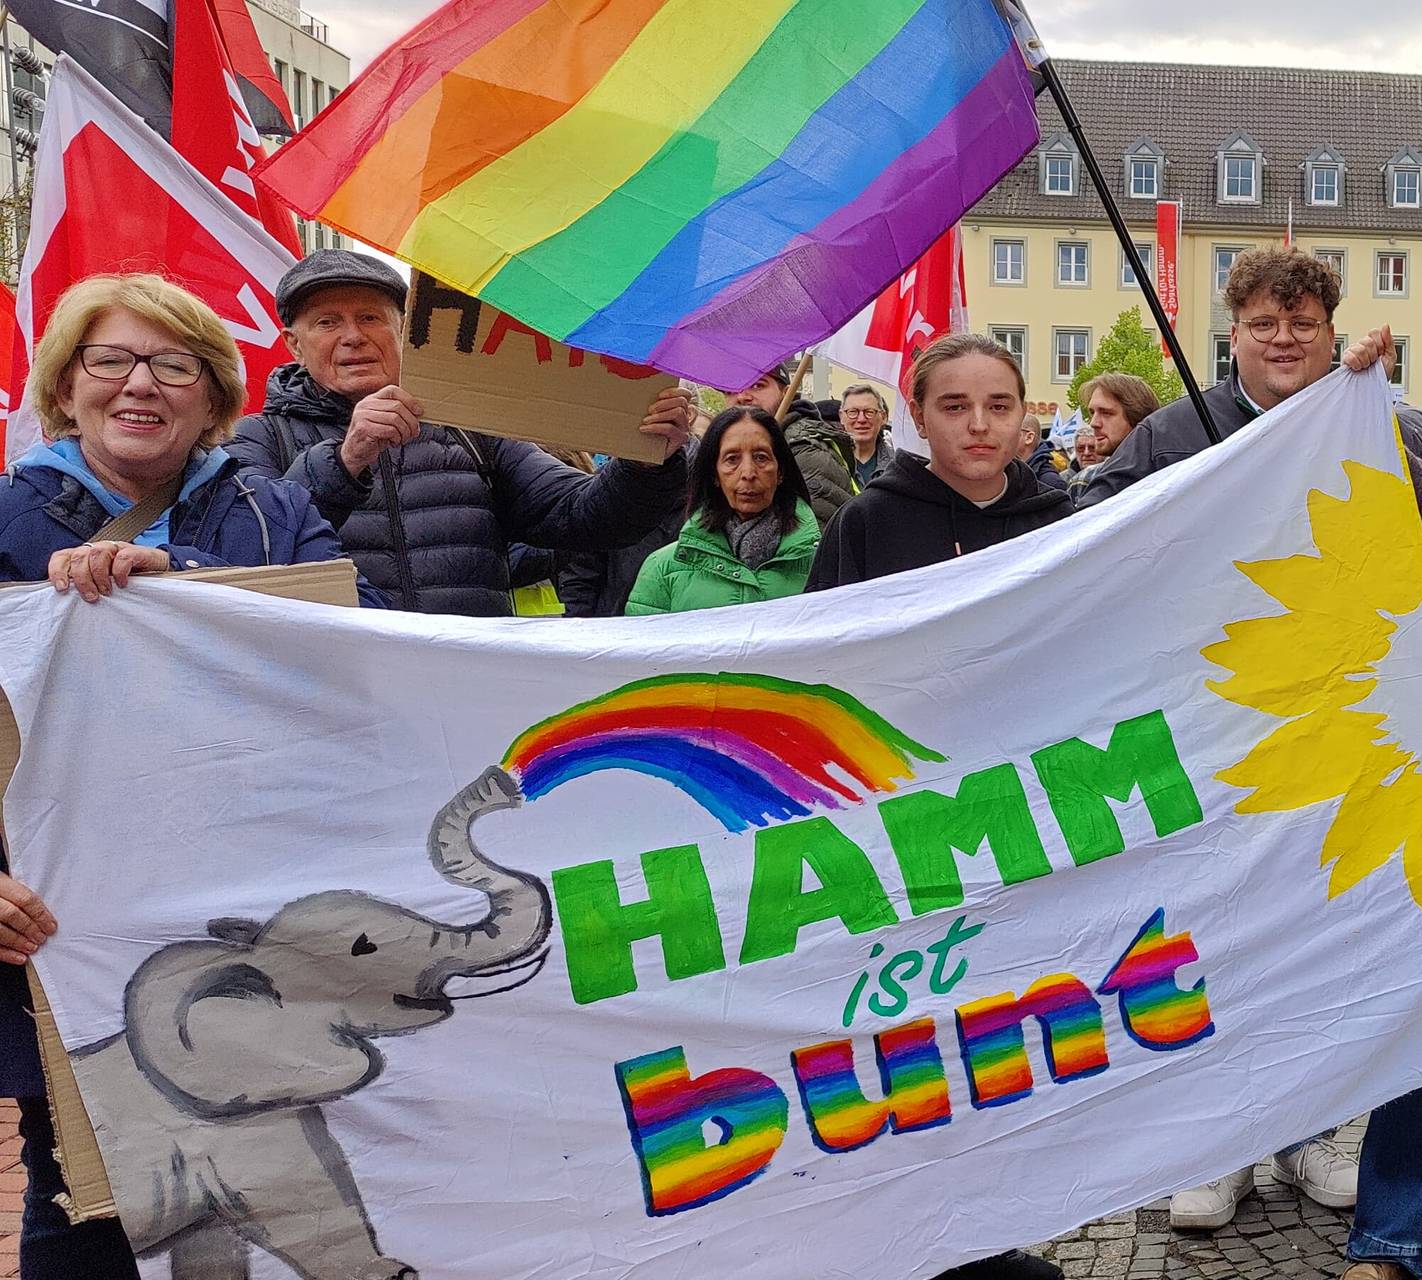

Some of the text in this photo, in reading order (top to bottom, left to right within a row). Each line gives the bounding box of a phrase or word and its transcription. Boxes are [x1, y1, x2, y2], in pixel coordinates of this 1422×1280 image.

[551, 709, 1204, 1005] HAMM
[842, 914, 987, 1027] ist
[614, 907, 1217, 1217] bunt
